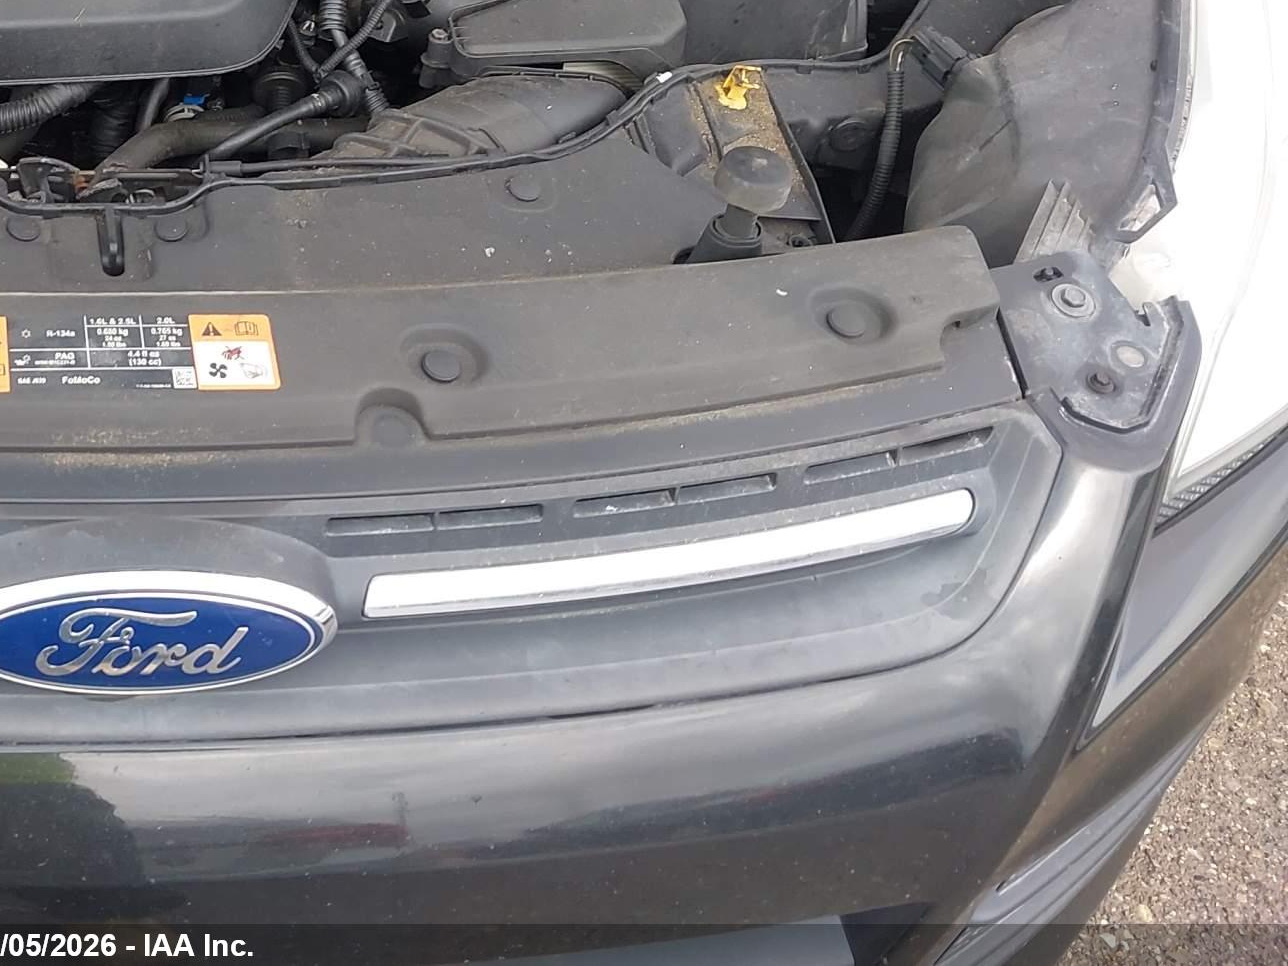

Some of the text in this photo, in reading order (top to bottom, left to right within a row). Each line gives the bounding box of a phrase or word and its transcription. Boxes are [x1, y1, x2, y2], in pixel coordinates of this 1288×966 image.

[118, 328, 129, 337] kg
[172, 328, 183, 336] kg
[55, 352, 75, 360] PAG
[61, 375, 101, 384] FoMoCo
[35, 607, 250, 677] Ford
